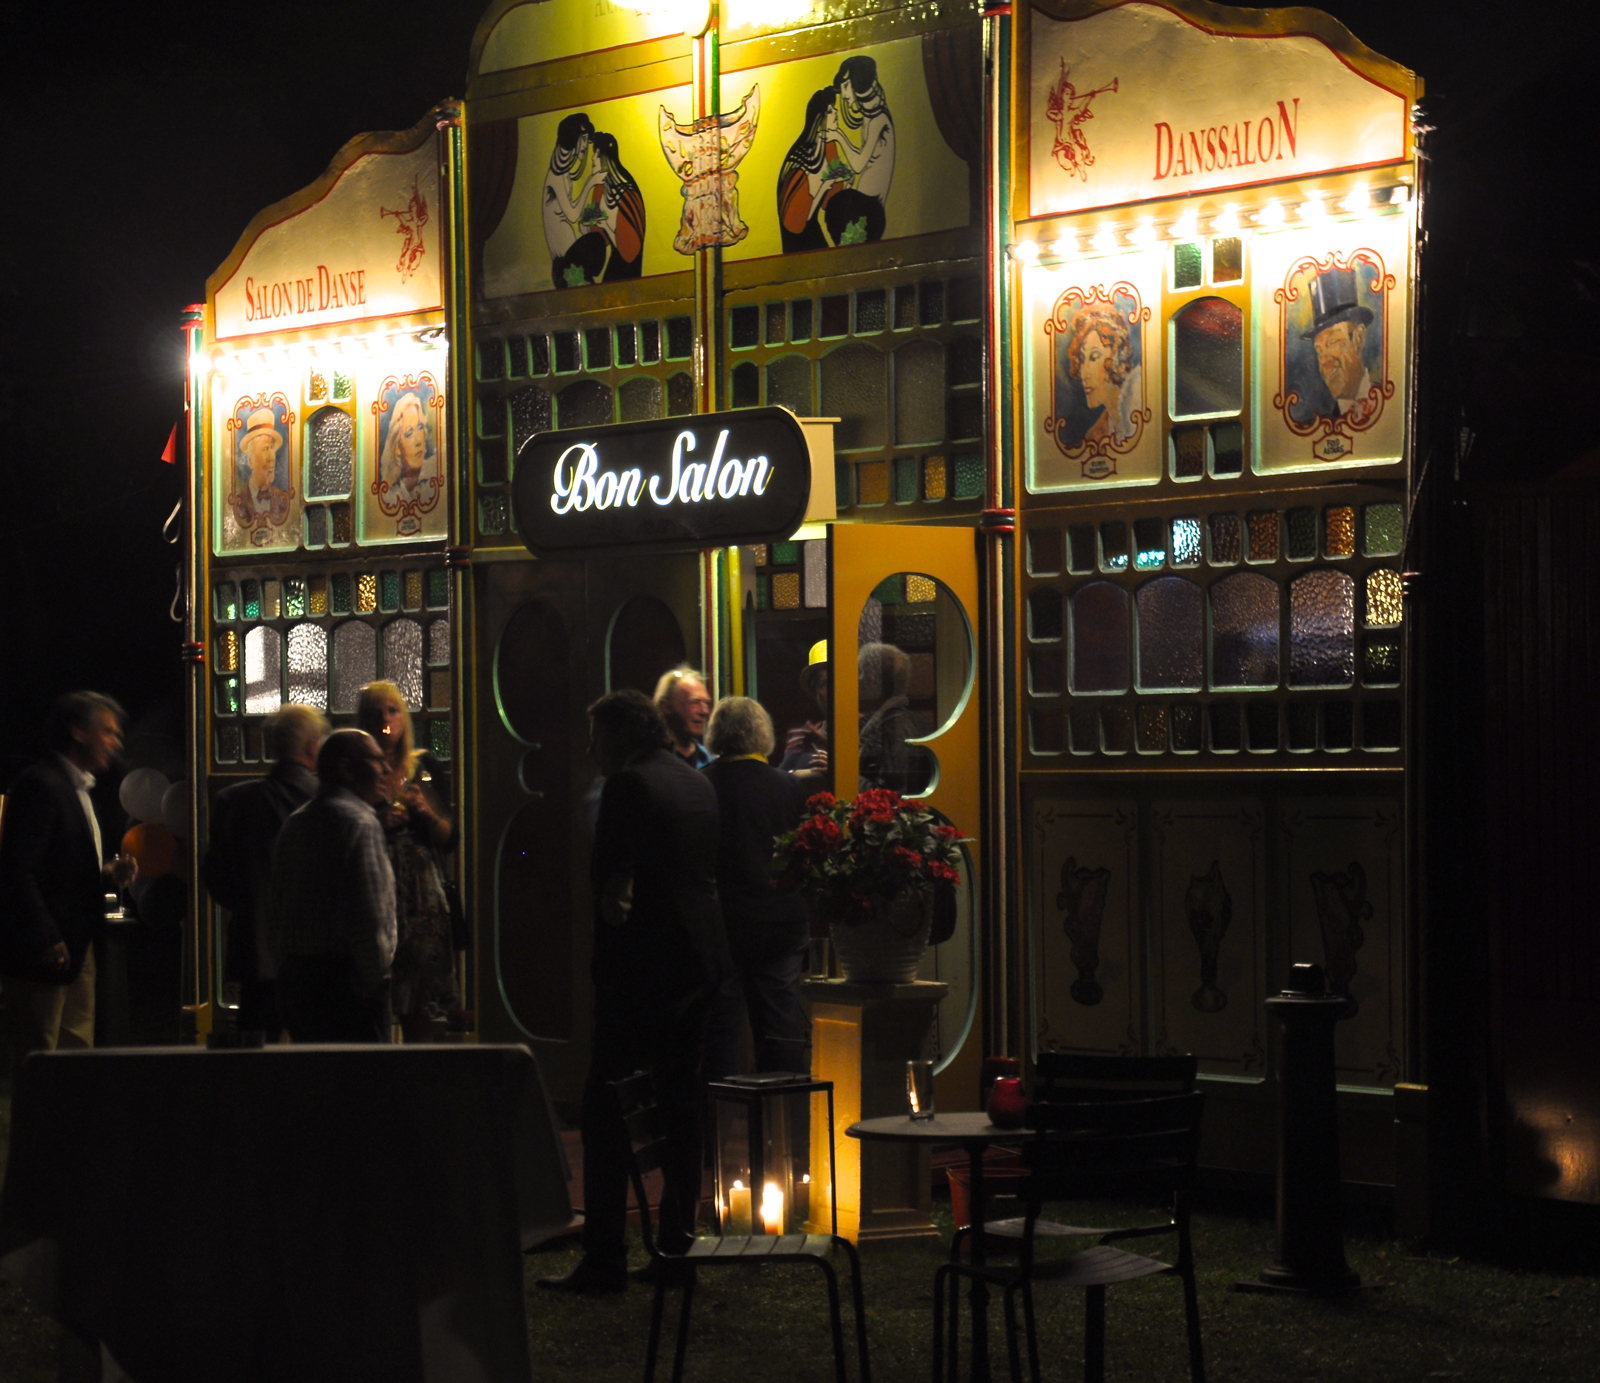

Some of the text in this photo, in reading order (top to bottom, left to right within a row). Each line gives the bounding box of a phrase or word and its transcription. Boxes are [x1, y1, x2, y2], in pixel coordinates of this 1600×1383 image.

[1153, 98, 1300, 181] DANSSALON
[245, 265, 366, 322] SALON DE DANSE
[551, 430, 774, 515] Bon Salon
